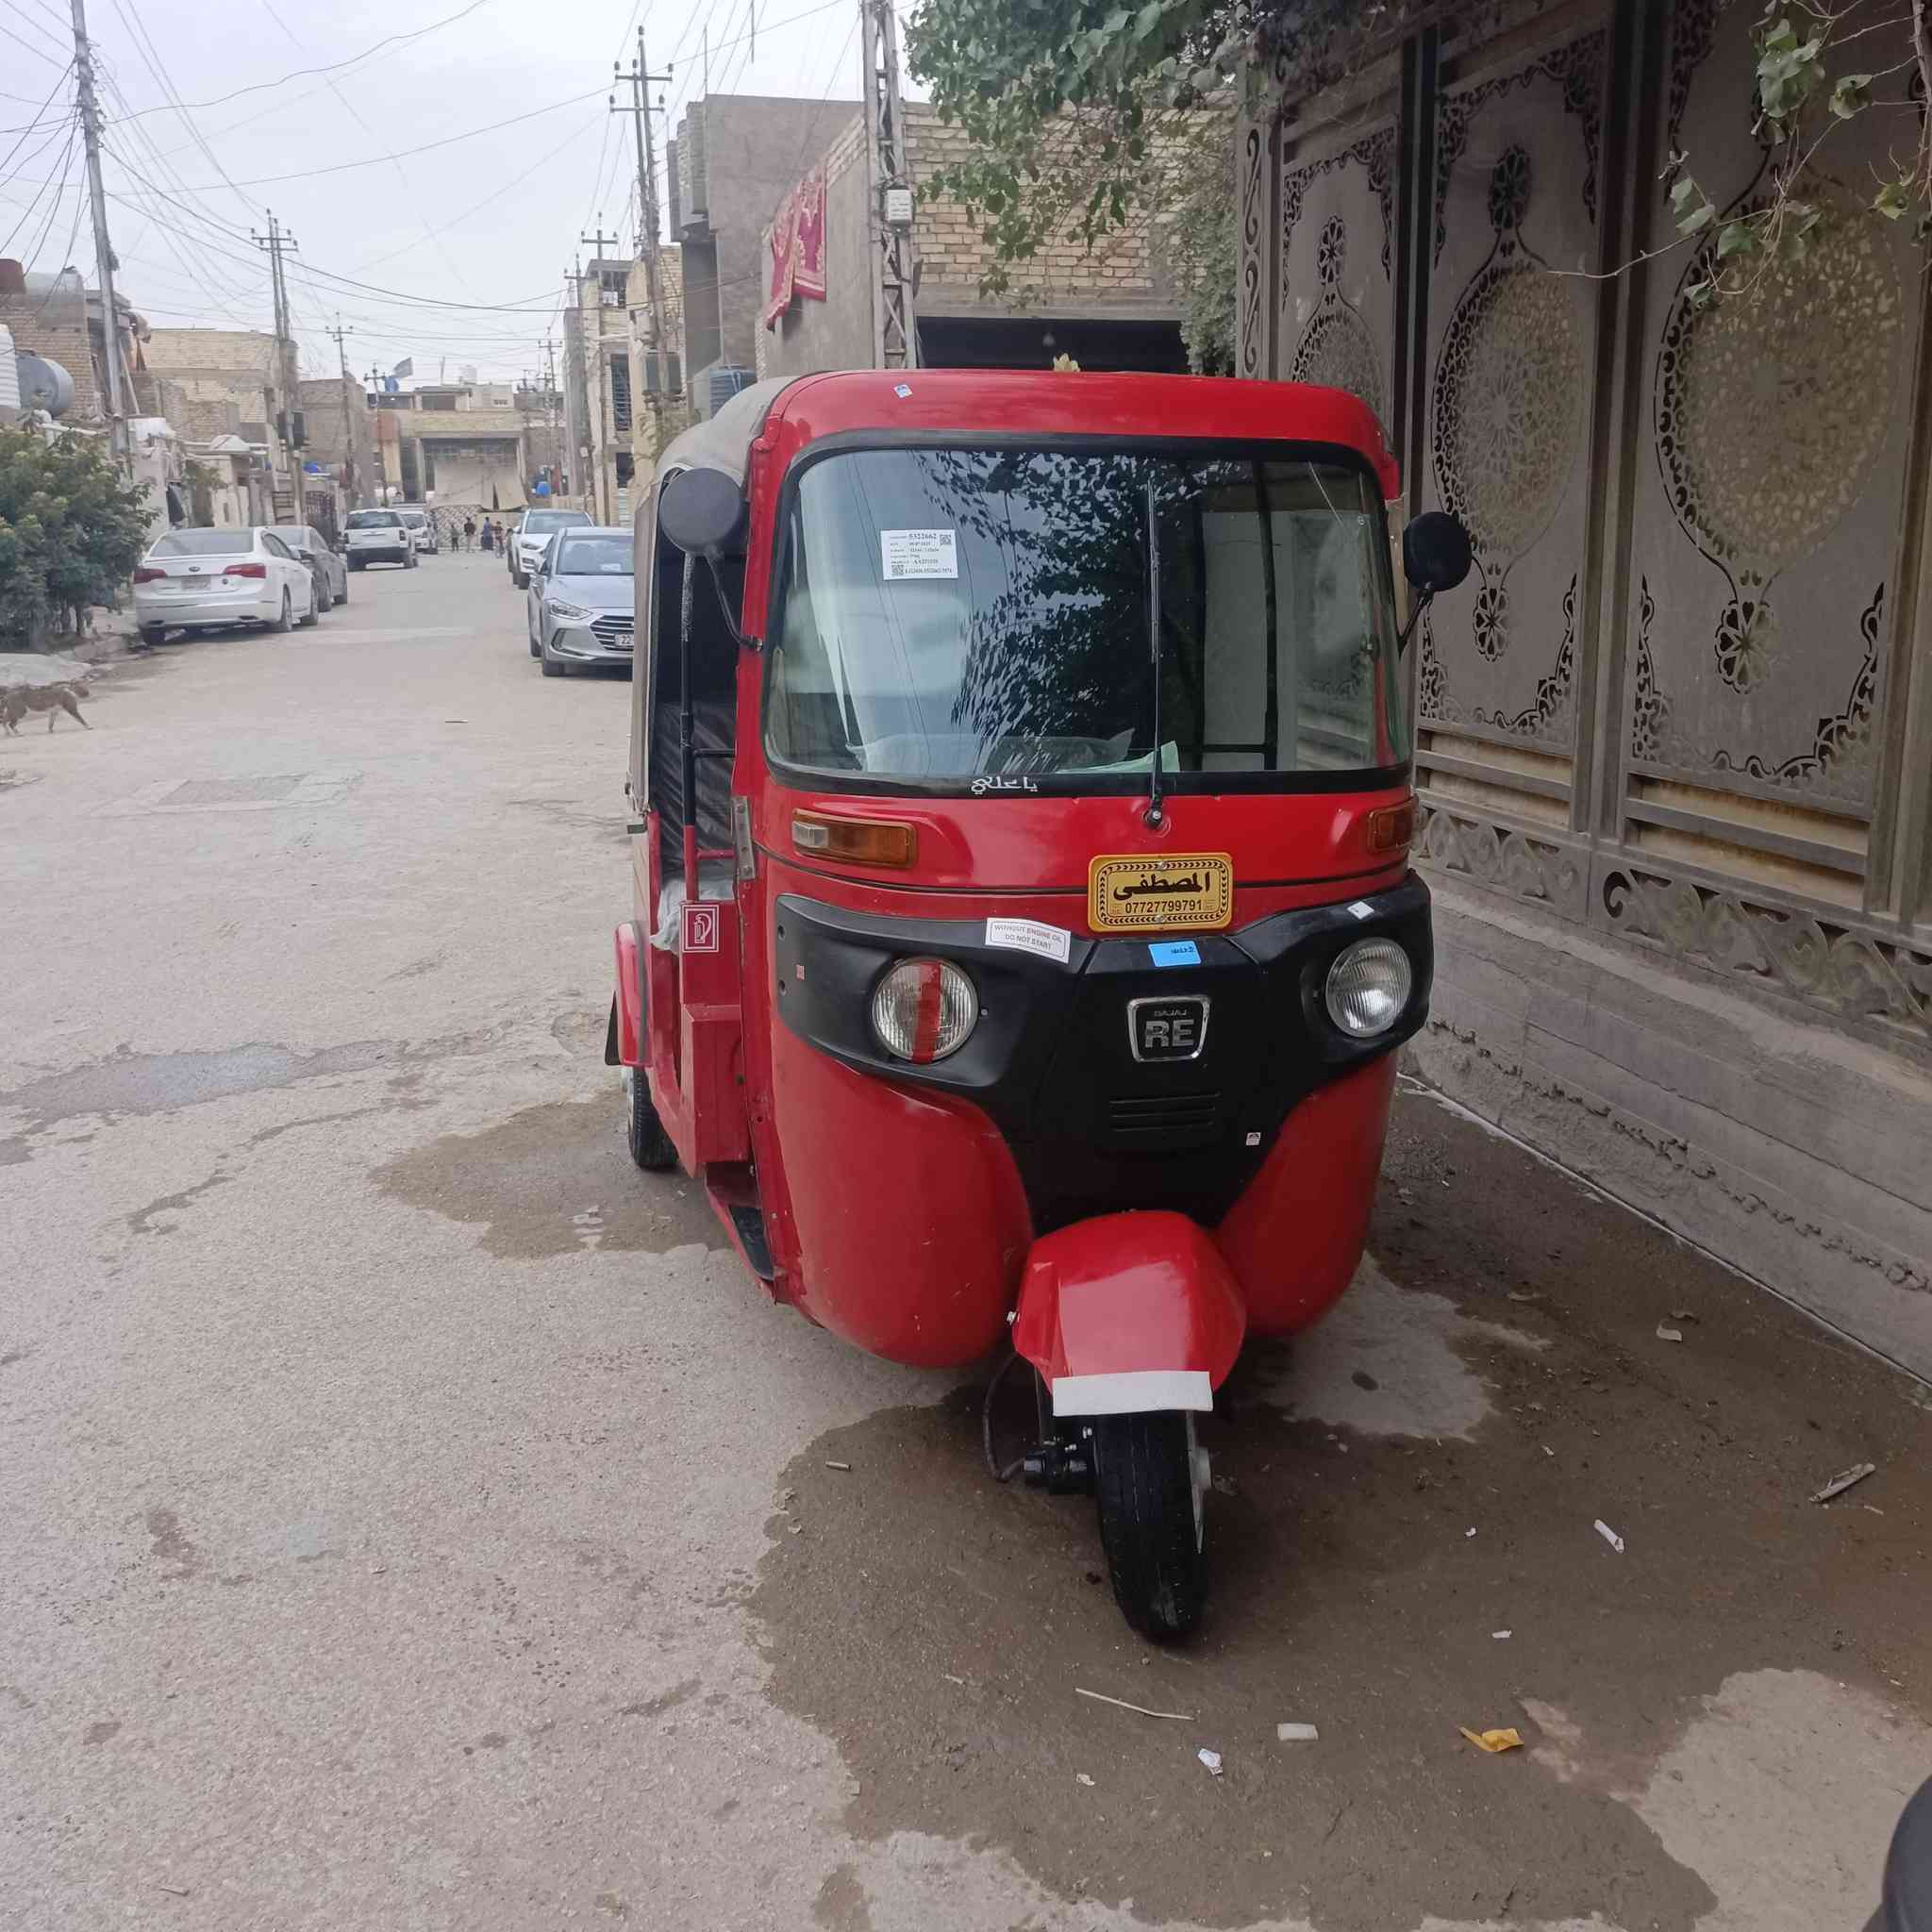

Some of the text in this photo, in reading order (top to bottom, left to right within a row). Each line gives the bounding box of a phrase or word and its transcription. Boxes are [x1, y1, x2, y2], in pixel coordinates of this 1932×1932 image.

[1113, 871, 1211, 900] المصطفى
[1124, 899, 1202, 913] 07727799791
[993, 924, 1026, 933] WITHOUT
[1016, 935, 1030, 944] NOT
[1031, 938, 1051, 950] START
[1145, 1019, 1195, 1048] RE
